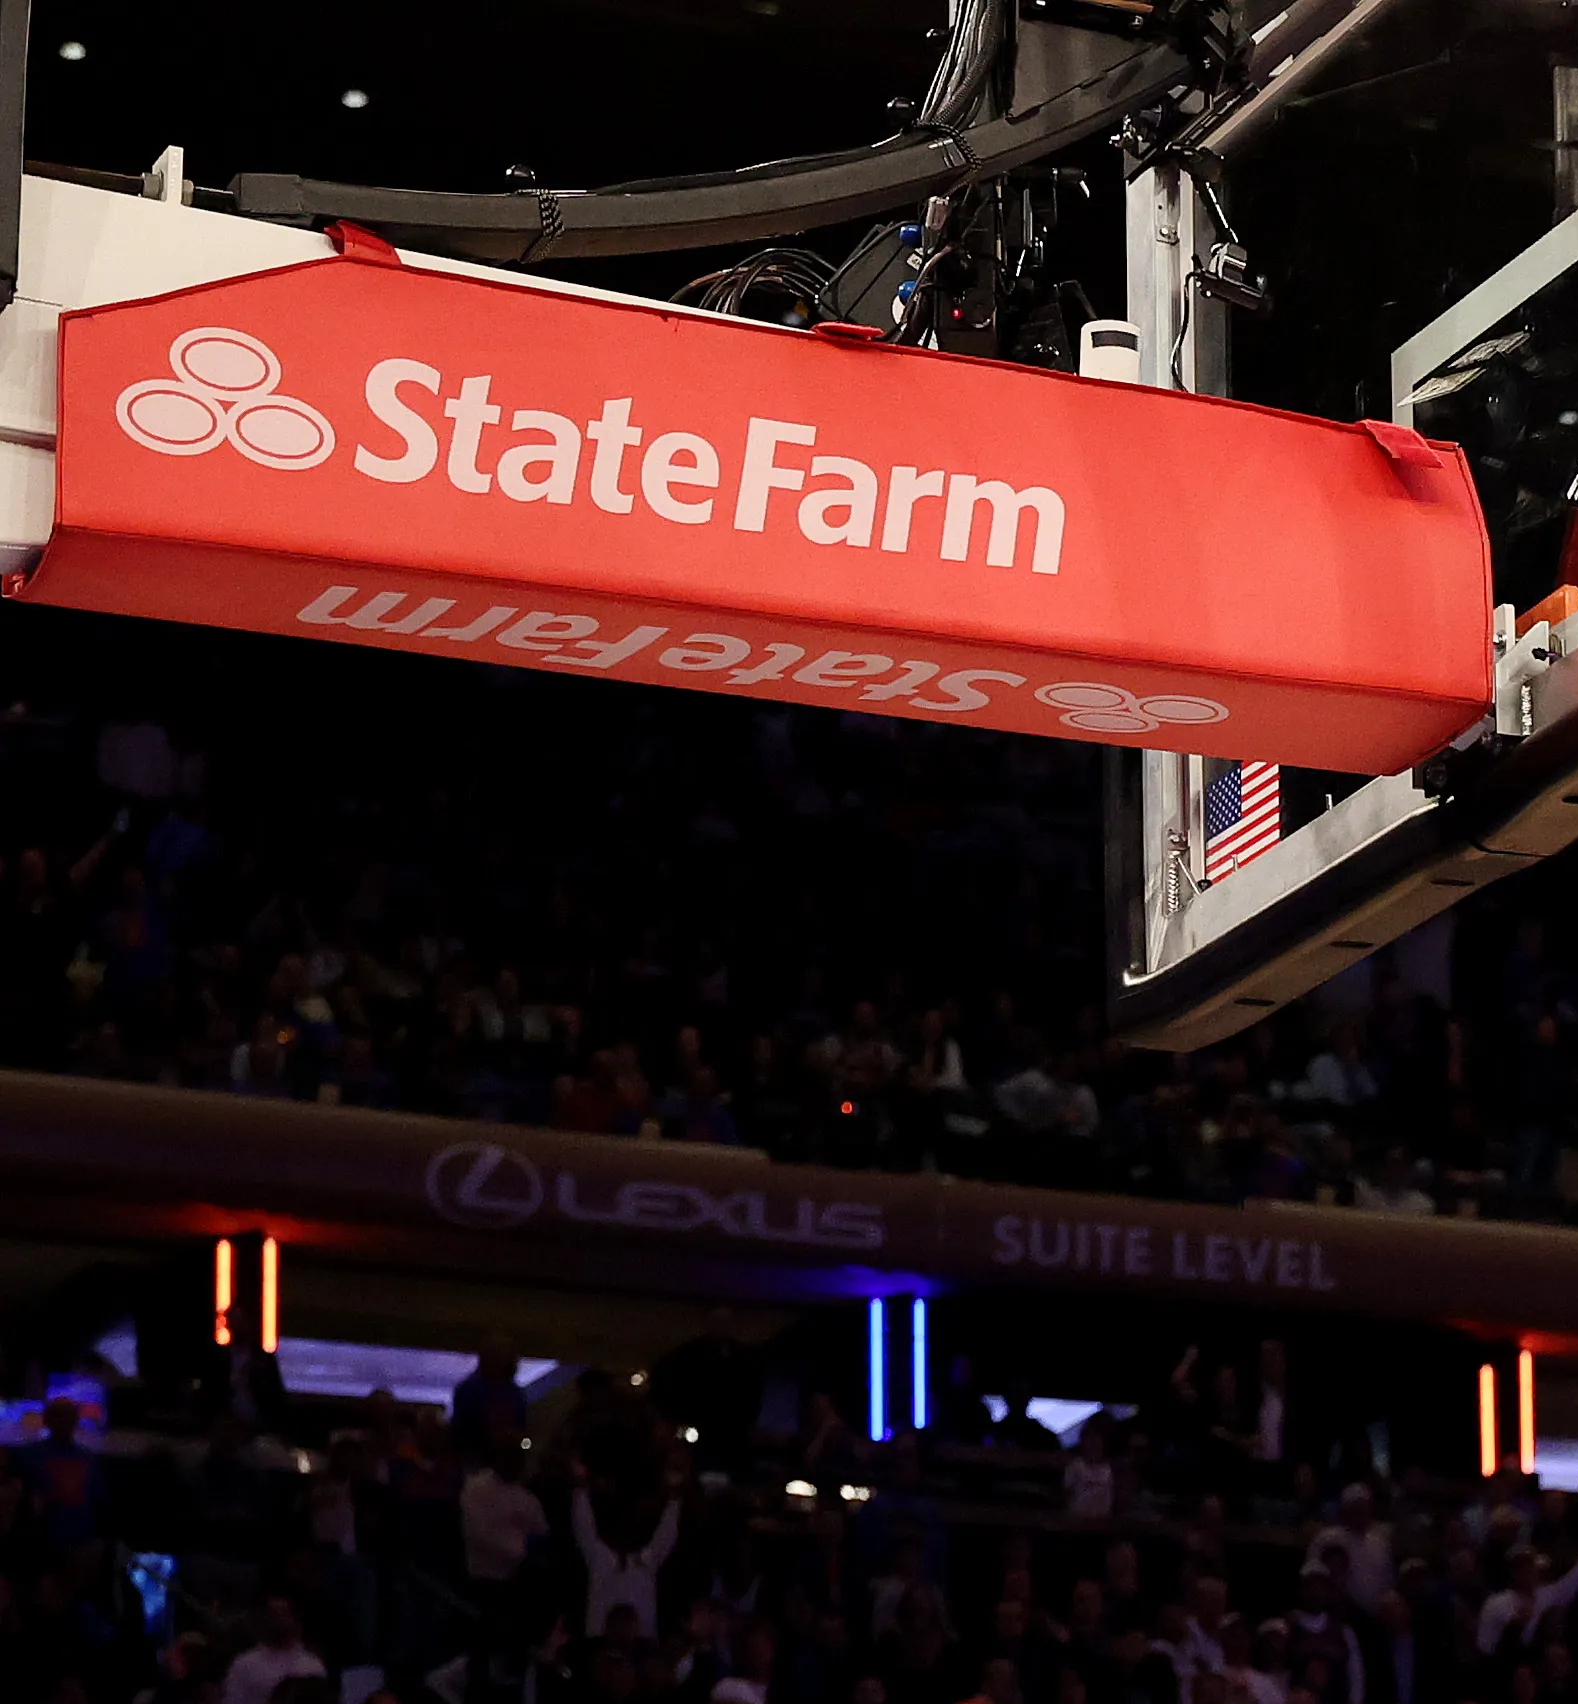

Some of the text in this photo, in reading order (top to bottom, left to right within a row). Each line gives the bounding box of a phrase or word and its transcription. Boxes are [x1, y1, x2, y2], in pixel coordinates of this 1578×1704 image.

[555, 1171, 887, 1249] LEXUS
[992, 1214, 1336, 1292] SUITE LEVEL
